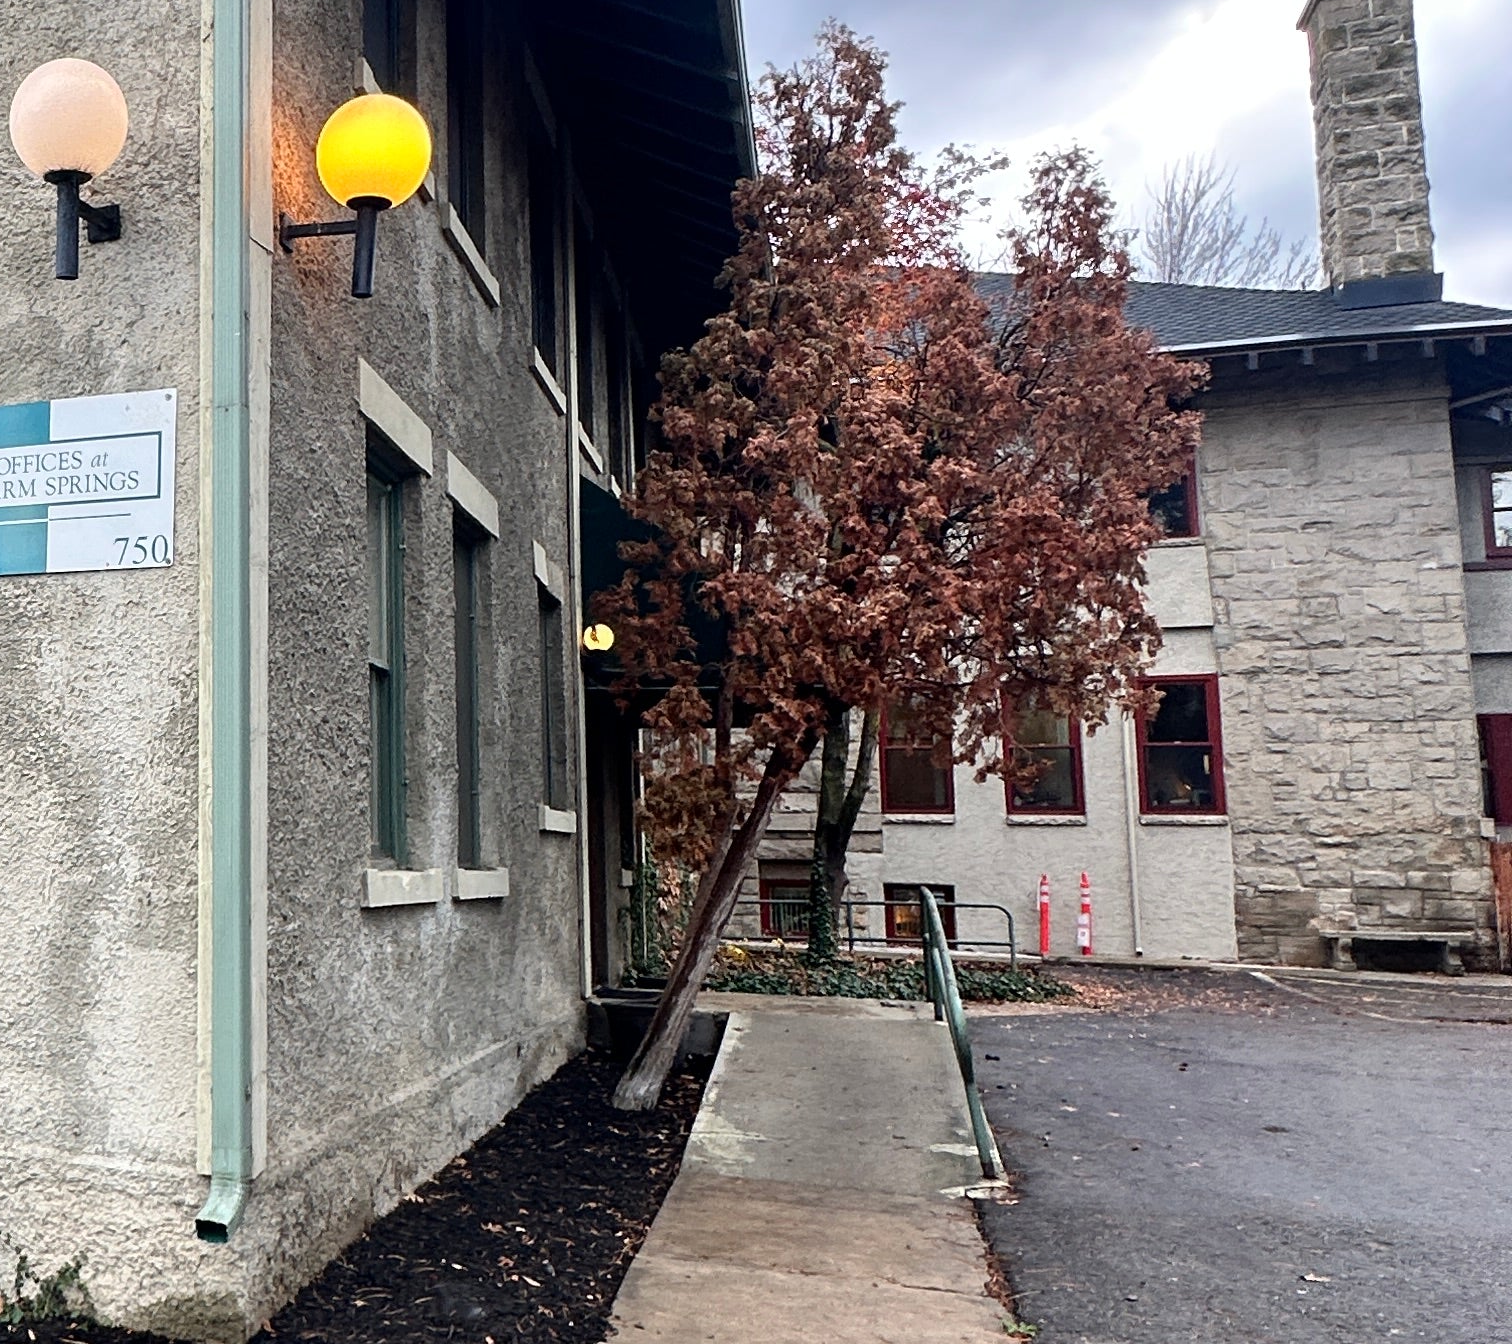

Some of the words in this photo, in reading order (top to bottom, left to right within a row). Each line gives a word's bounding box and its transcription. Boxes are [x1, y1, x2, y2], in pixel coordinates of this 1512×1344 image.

[90, 451, 109, 469] at
[45, 470, 140, 496] SPRINGS
[113, 534, 169, 565] 750
